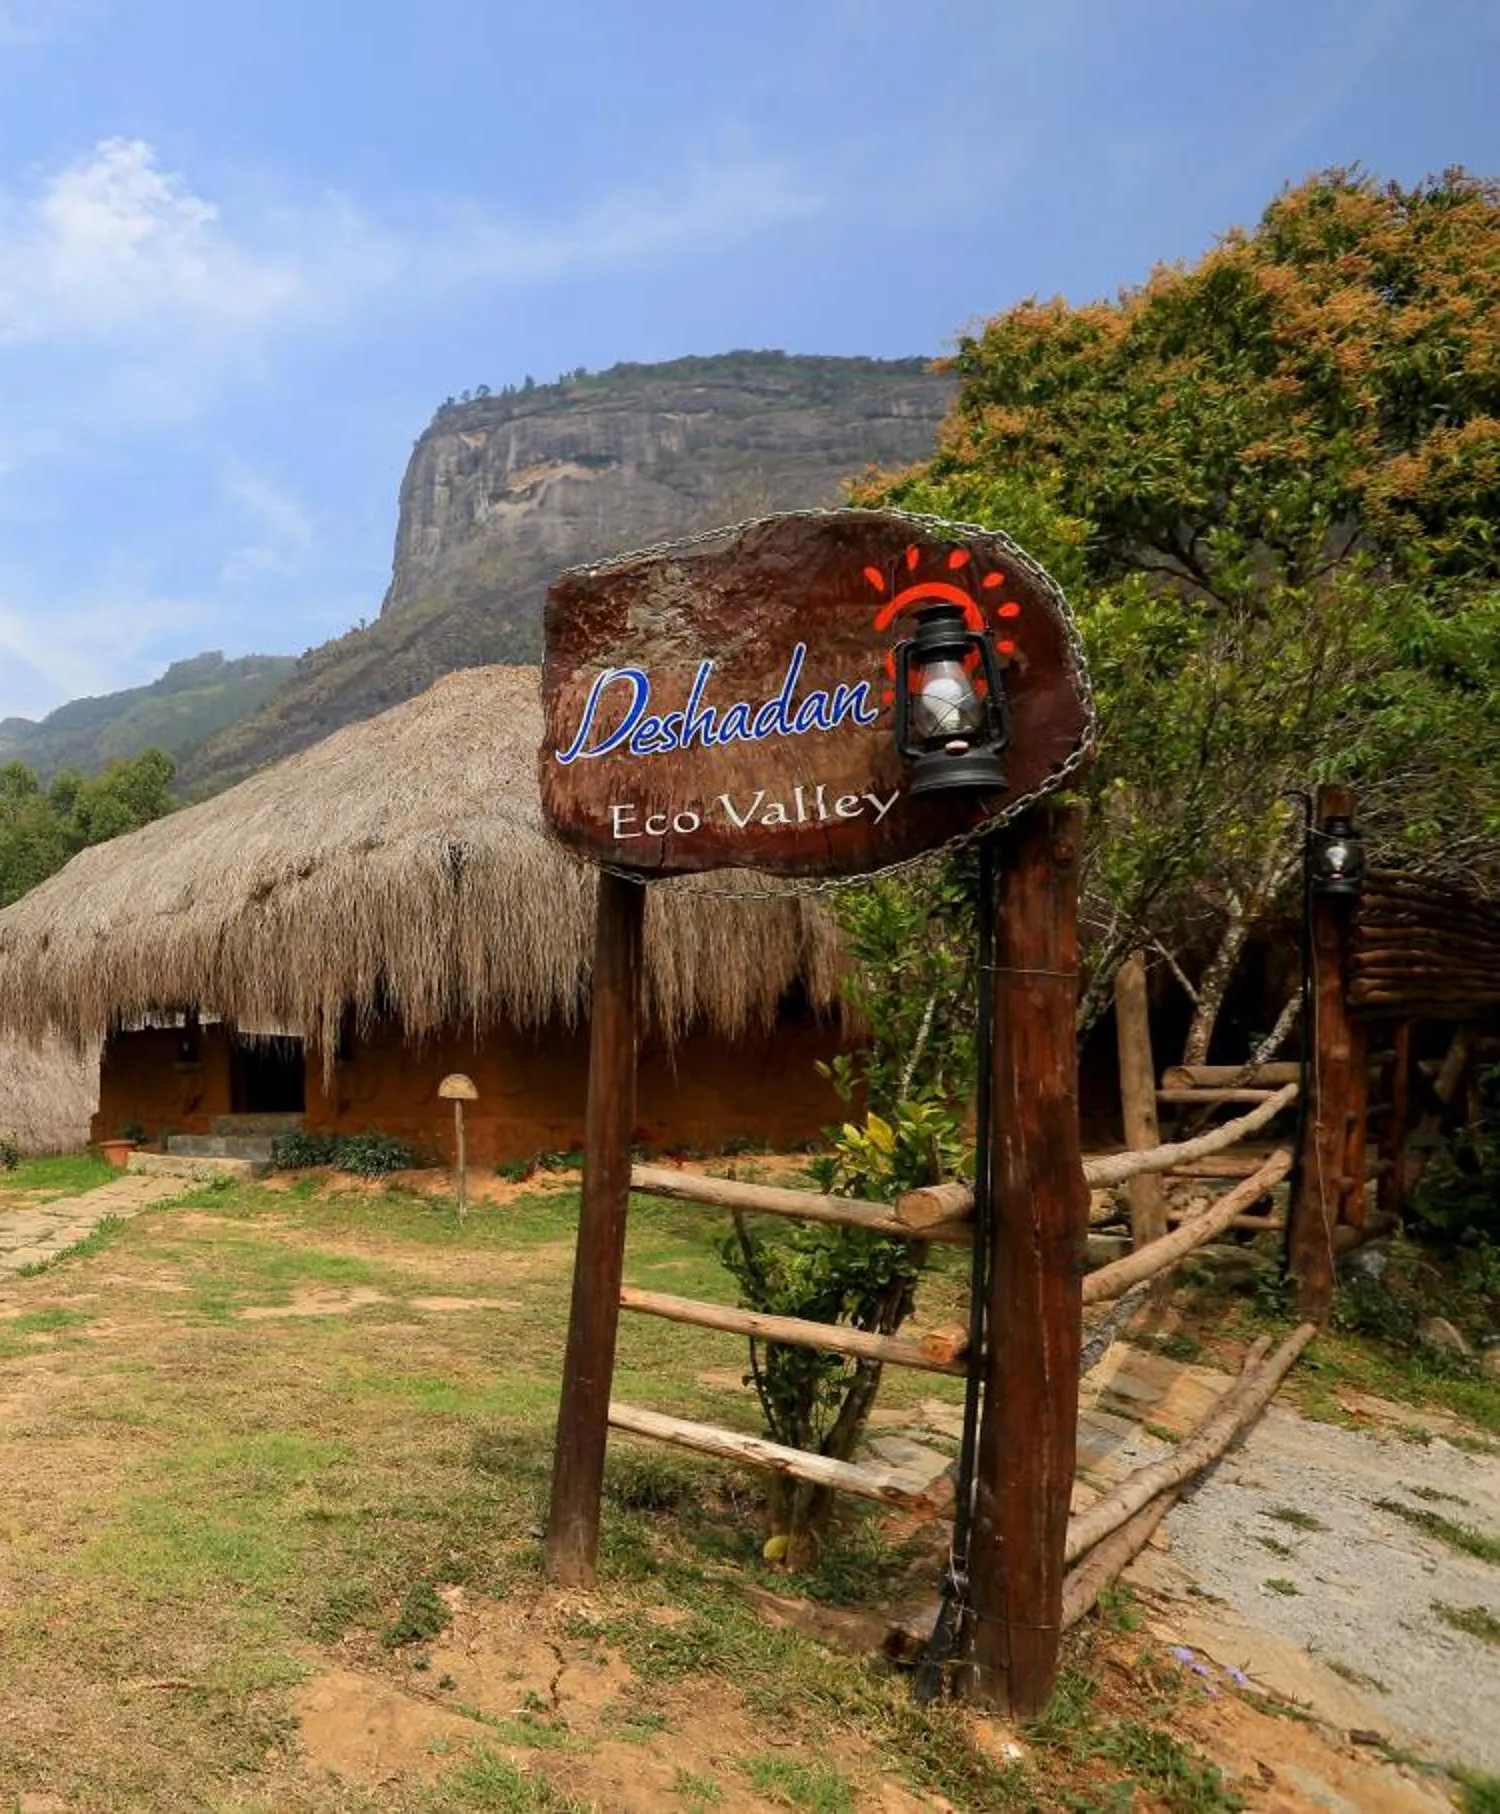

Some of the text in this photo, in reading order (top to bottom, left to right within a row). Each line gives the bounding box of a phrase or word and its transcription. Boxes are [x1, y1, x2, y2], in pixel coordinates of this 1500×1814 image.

[555, 642, 878, 764] Deshadan
[609, 783, 900, 839] Eco Valley
